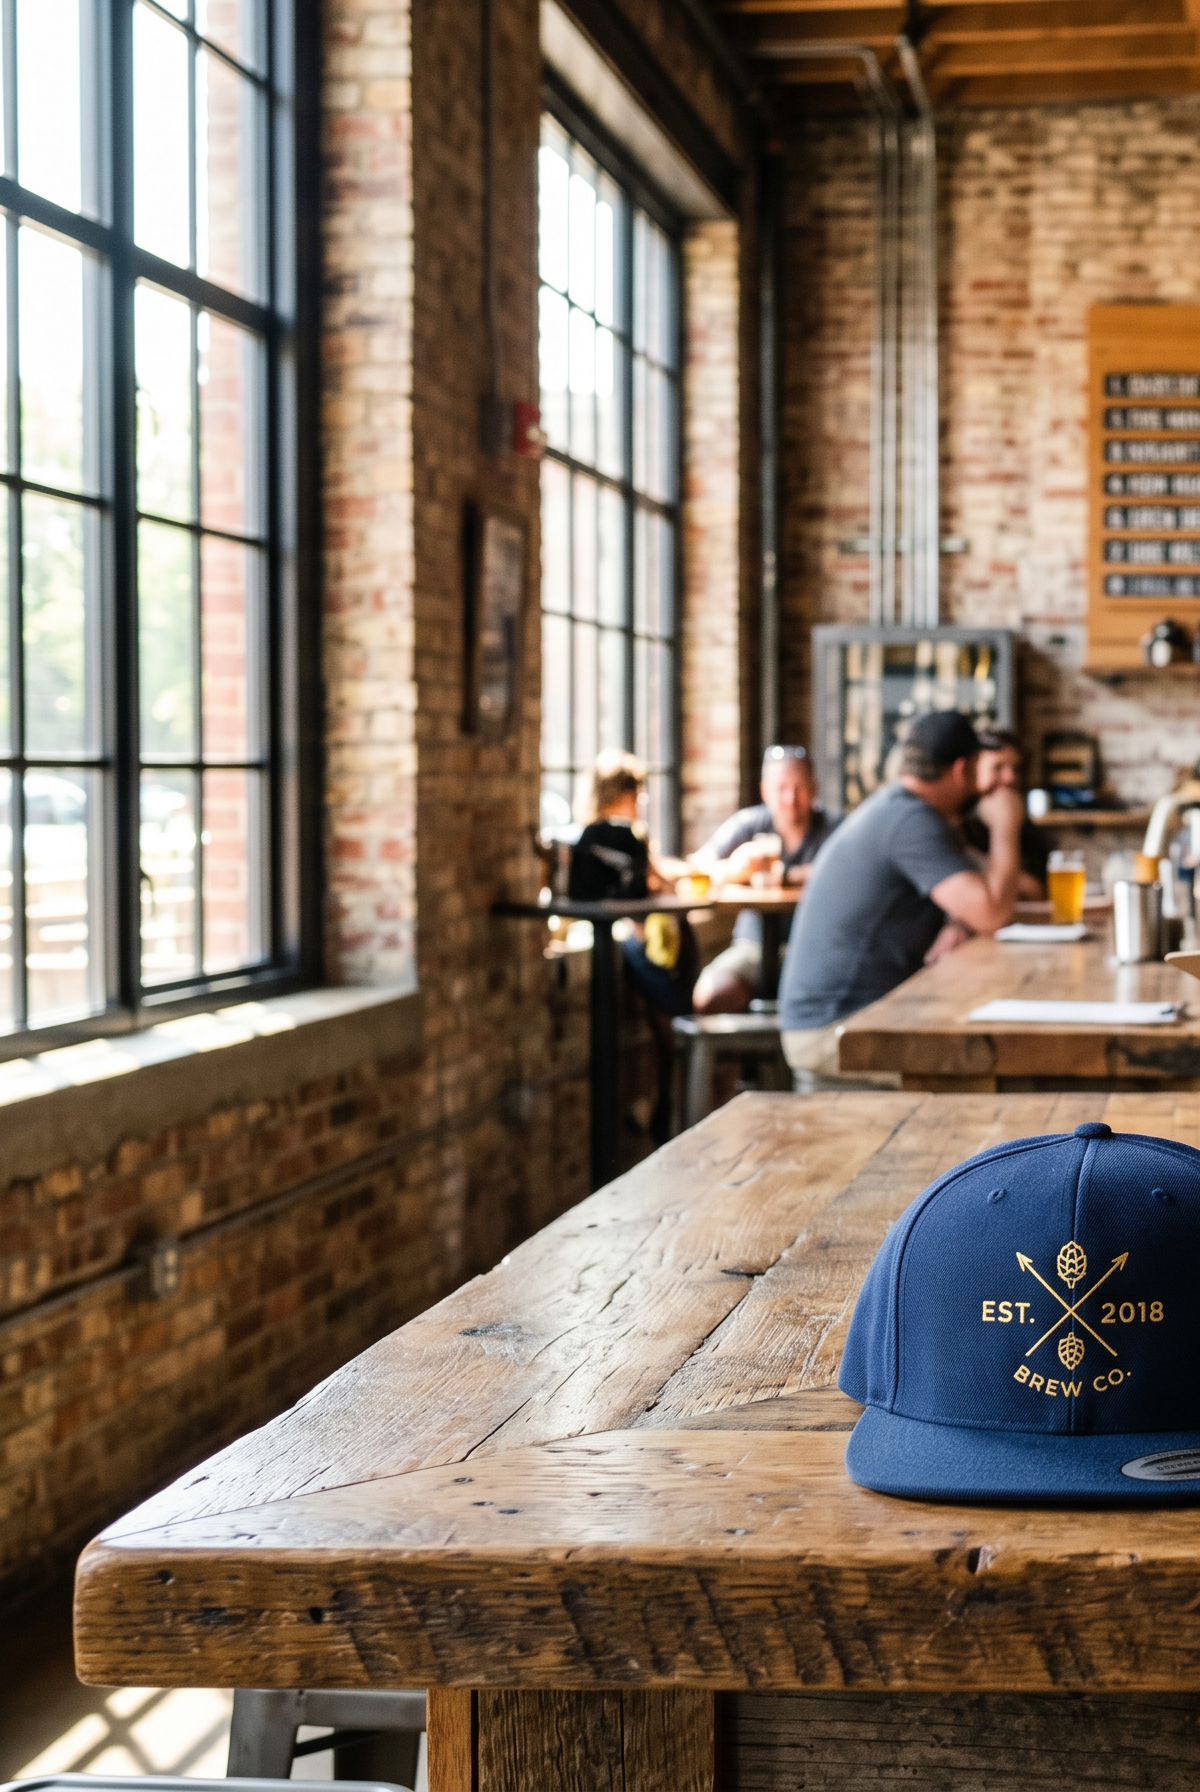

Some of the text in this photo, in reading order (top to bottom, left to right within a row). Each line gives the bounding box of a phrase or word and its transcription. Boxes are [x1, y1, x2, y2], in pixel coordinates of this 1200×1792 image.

[982, 1300, 1165, 1324] EST. 2018
[1013, 1364, 1132, 1398] BREW CO.
